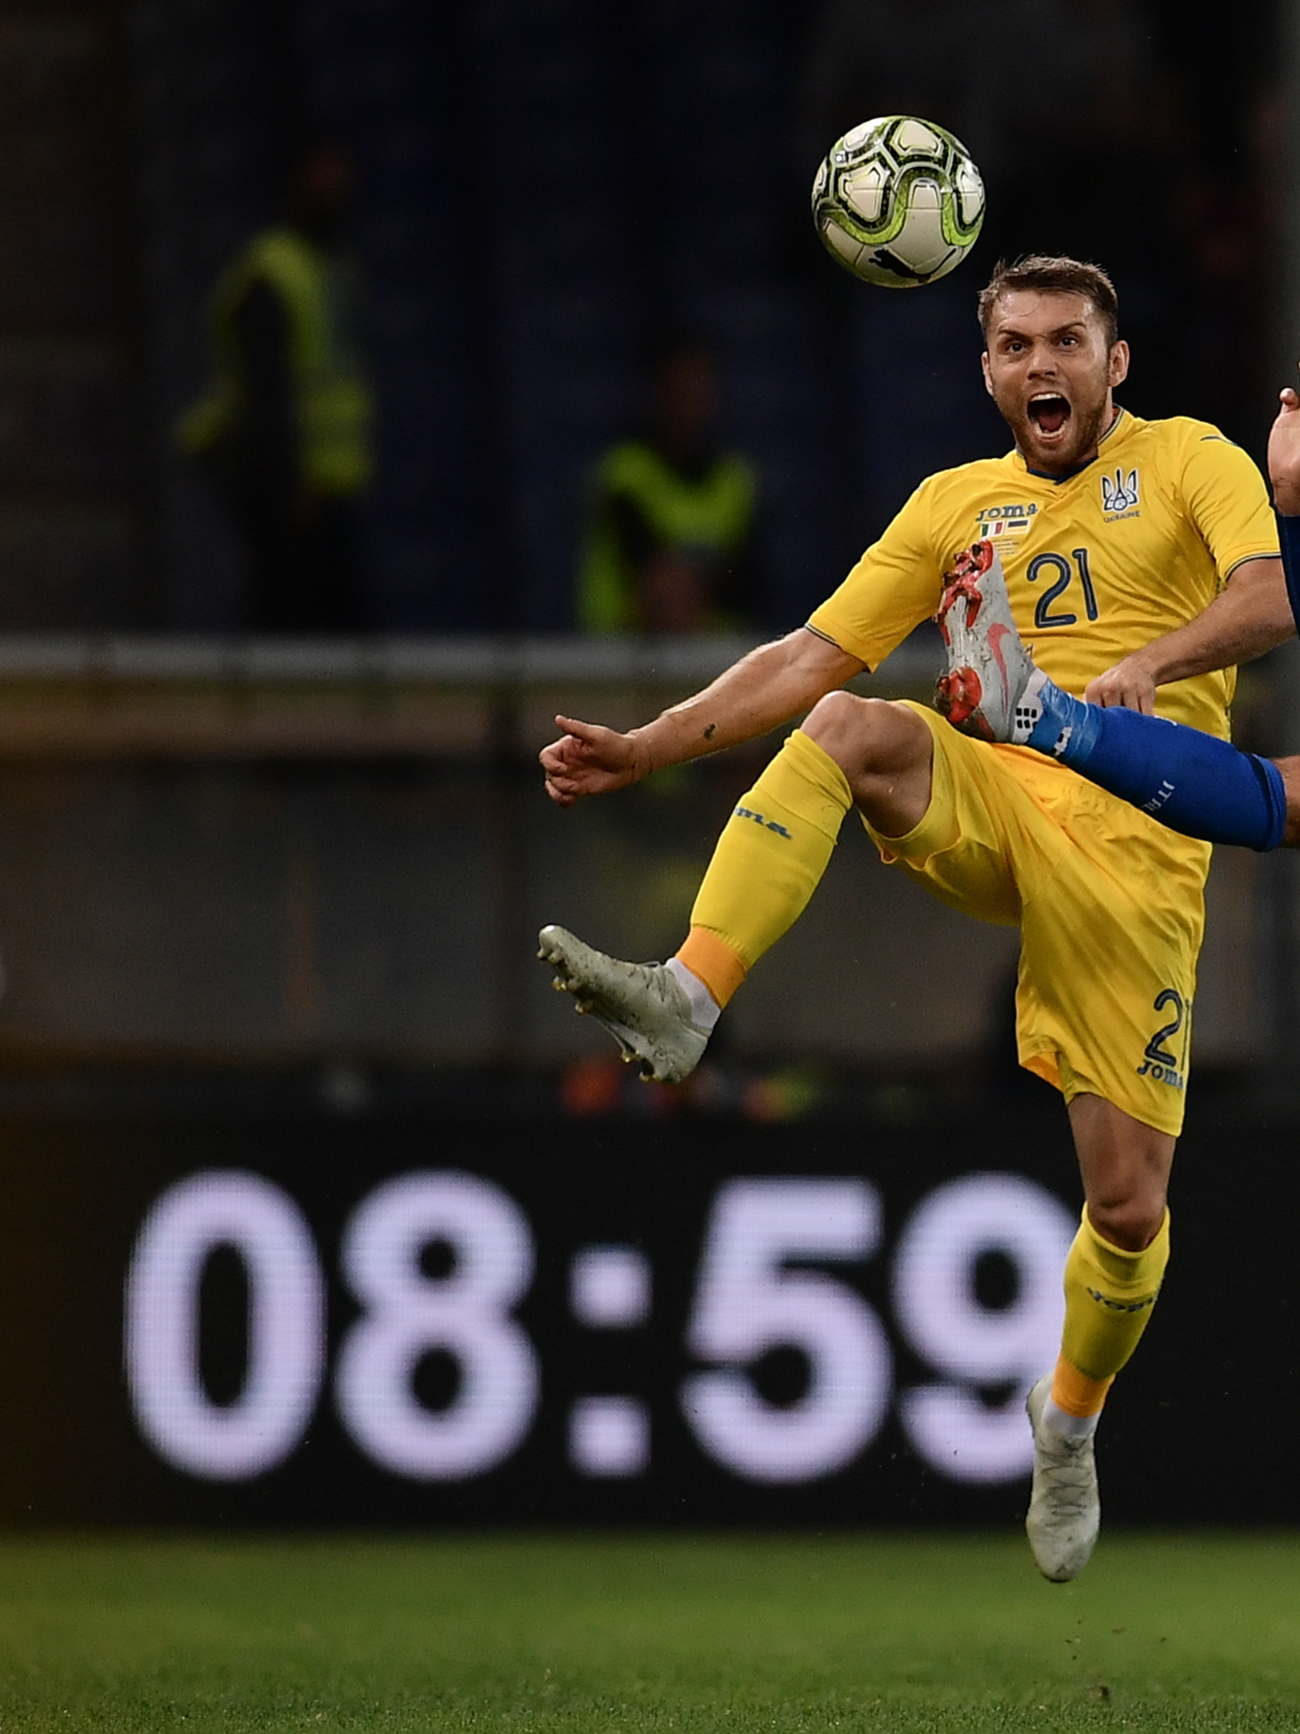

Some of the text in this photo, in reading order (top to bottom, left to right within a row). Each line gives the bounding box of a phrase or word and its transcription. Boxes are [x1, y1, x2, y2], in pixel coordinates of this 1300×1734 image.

[1026, 547, 1098, 628] 21
[735, 807, 792, 840] ma
[1140, 779, 1175, 812] ITAL
[122, 1168, 1082, 1484] 08:59
